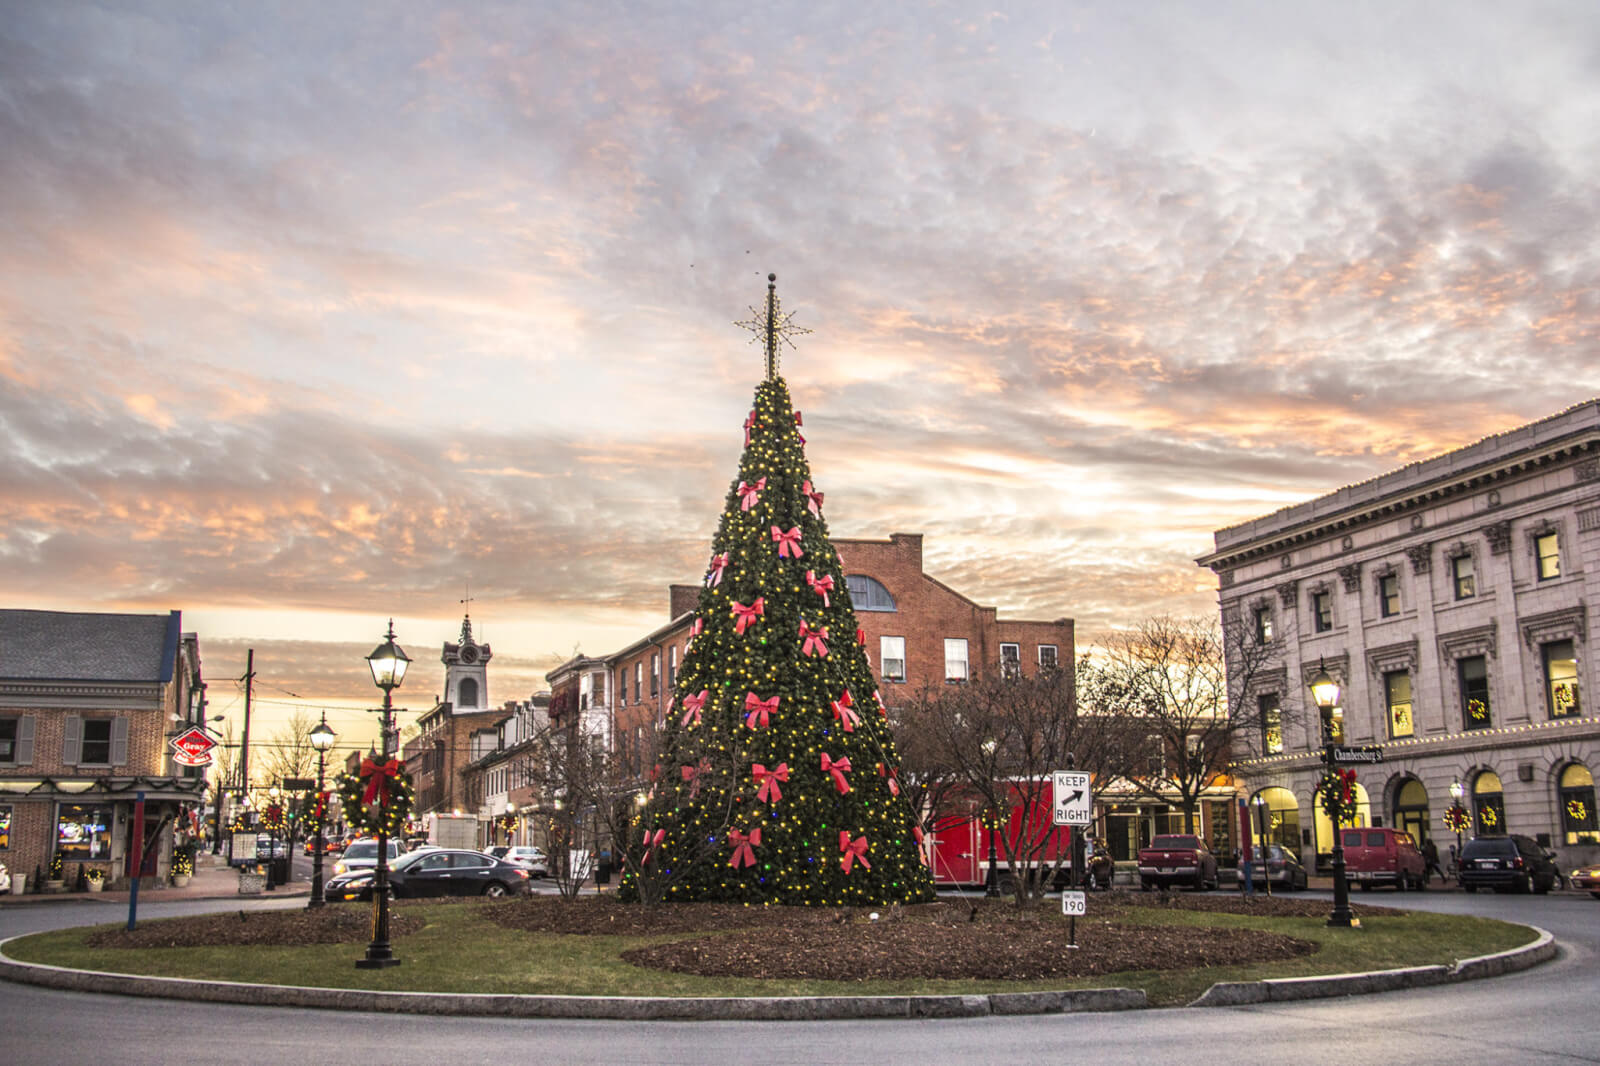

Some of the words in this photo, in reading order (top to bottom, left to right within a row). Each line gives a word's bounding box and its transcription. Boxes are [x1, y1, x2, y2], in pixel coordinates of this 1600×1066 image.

[183, 742, 205, 752] Gray
[1058, 776, 1086, 786] KEEP
[1056, 809, 1088, 820] RIGHT
[1064, 901, 1084, 912] 190
